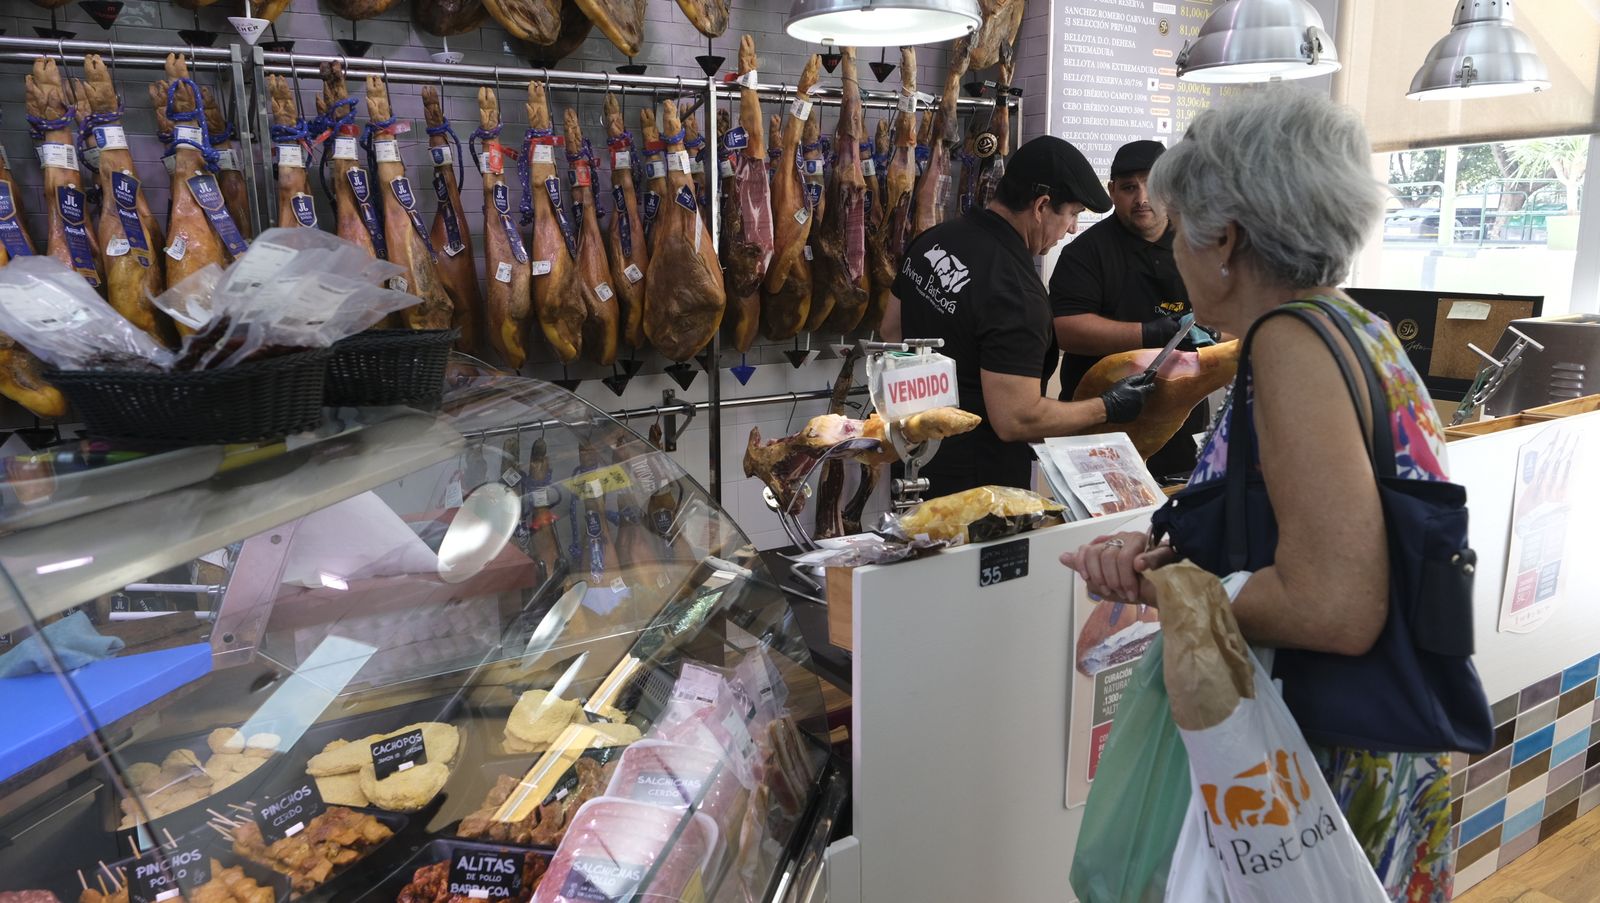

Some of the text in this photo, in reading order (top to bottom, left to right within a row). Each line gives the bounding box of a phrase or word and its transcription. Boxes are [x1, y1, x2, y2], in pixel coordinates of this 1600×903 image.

[1064, 6, 1156, 25] SANCHEZ ROMERO CARVAJAL
[1072, 18, 1109, 29] SELECCIÓN
[1110, 22, 1136, 33] PRIVADA
[1064, 32, 1096, 44] BELLOTA
[1111, 38, 1136, 48] DEHESA
[1064, 44, 1114, 57] EXTREMADURA
[1063, 58, 1095, 69] BELLOTA
[1111, 63, 1158, 75] EXTREMADURA
[1063, 73, 1095, 83] BELLOTA
[1096, 75, 1123, 85] RESERVA
[1063, 88, 1083, 96] CEBO
[1083, 88, 1110, 98] IBÉRICO
[1110, 91, 1134, 101] CAMPO
[1063, 102, 1082, 111] CEBO
[1083, 103, 1109, 113] IBÉRICO
[1110, 105, 1133, 114] CAMPO
[1062, 116, 1082, 125] CEBO
[1082, 116, 1109, 126] IBÉRICO
[1130, 120, 1154, 129] BLANCA
[1062, 131, 1099, 141] SELECCIÓN
[1100, 132, 1127, 142] CORONA
[1086, 143, 1113, 152] JUVILES
[902, 257, 923, 286] Divina
[925, 274, 957, 314] Pastora
[888, 372, 949, 405] VENDIDO
[981, 565, 1002, 587] 35
[1104, 667, 1133, 685] CURACIÓN
[372, 733, 423, 756] CACHOPOS
[638, 775, 701, 789] SALCHICHAS
[261, 785, 312, 820] PINCHOS
[273, 805, 303, 827] CERDO
[1231, 805, 1338, 876] Pastora
[135, 848, 202, 879] PINCHOS
[456, 855, 516, 874] ALITAS
[572, 861, 641, 880] SALCHICHAS
[149, 869, 188, 889] POLLO
[466, 872, 503, 882] DE POLLO
